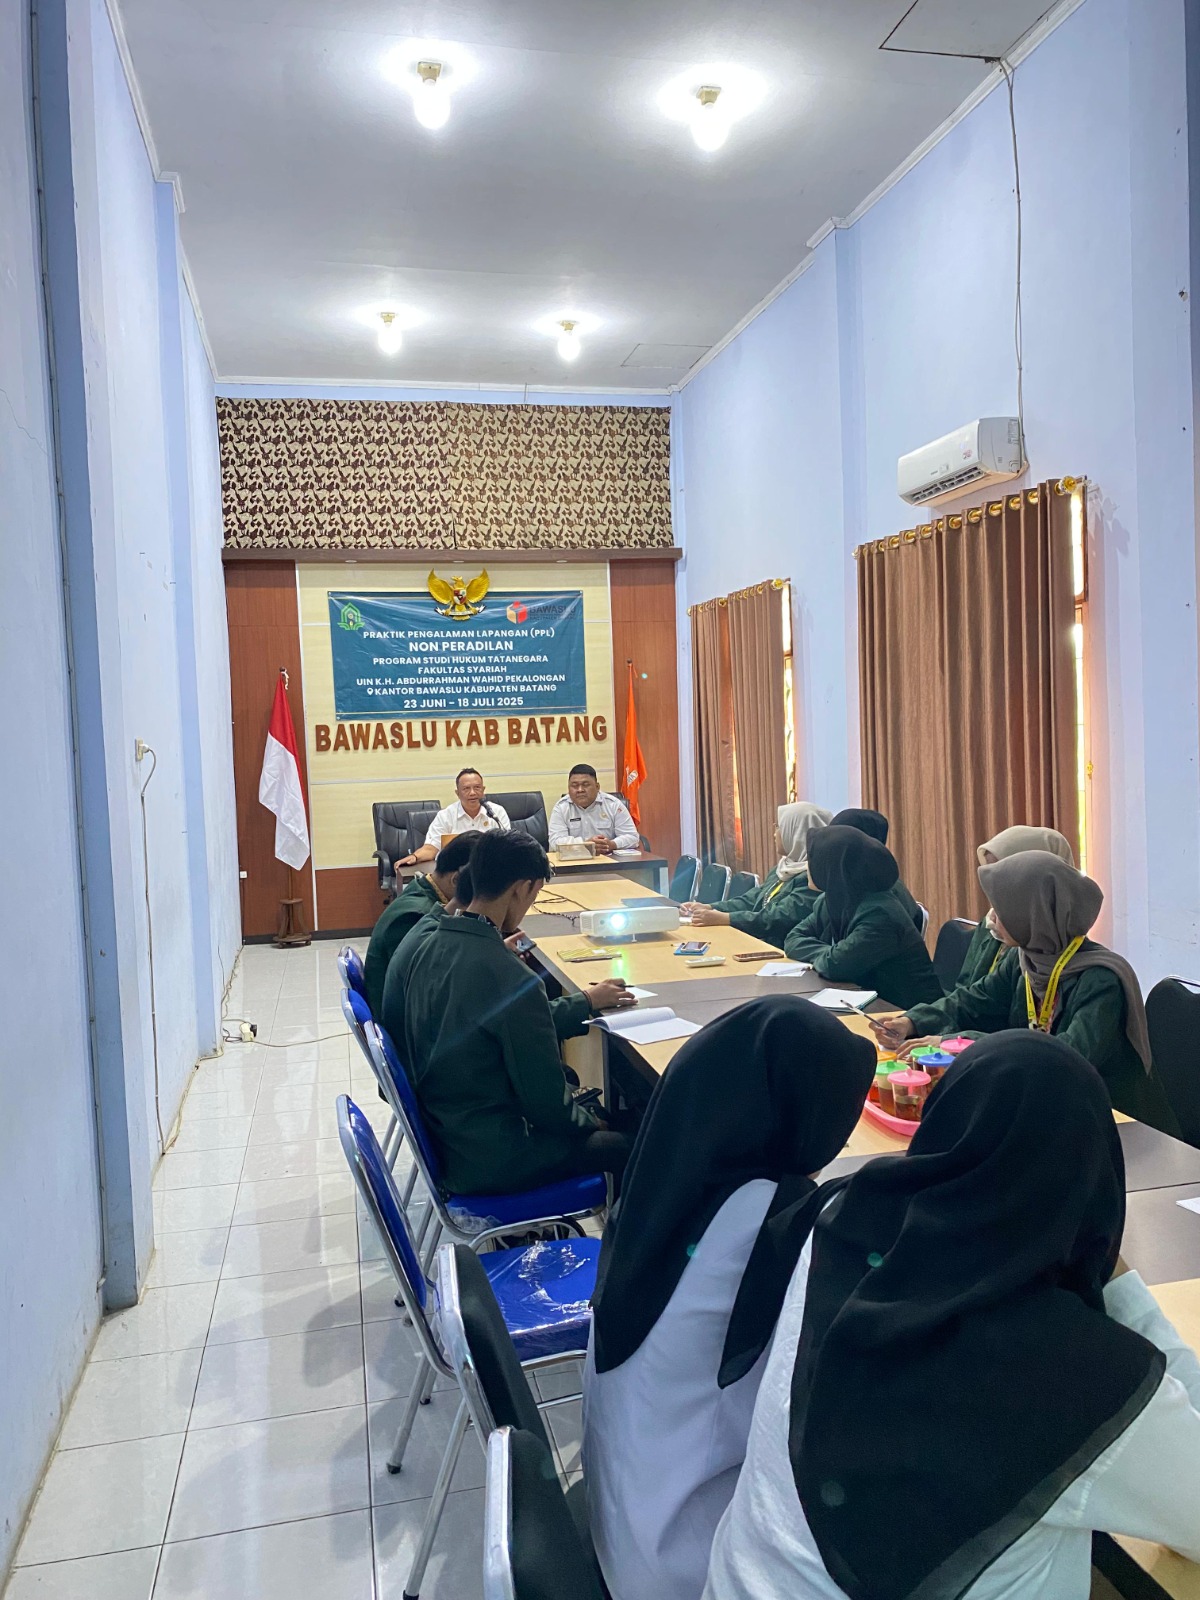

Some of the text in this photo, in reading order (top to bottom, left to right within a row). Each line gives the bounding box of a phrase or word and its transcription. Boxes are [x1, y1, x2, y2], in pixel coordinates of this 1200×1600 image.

[529, 605, 577, 614] BAWASU
[363, 627, 555, 639] PRAKTIK PENGALAMAN LAPANGAN (PPL)
[409, 640, 514, 652] NON PERADILAN
[373, 655, 549, 665] PROGRAM STUDI HUKUM TATANEGARA
[418, 665, 507, 675] FAKULTAS SYARIAH
[356, 674, 566, 686] UIN K.H. ABDURRAHMAN WAHID PEKALONGAN
[375, 684, 557, 696] KANTOR BAWASLU KABUPATEN BATANG
[403, 699, 418, 709] 23
[420, 698, 447, 708] JUNI
[457, 697, 470, 707] 18
[471, 697, 495, 707] JULI
[497, 696, 524, 706] 2025
[315, 715, 608, 752] BAWASLU KAB BATANG
